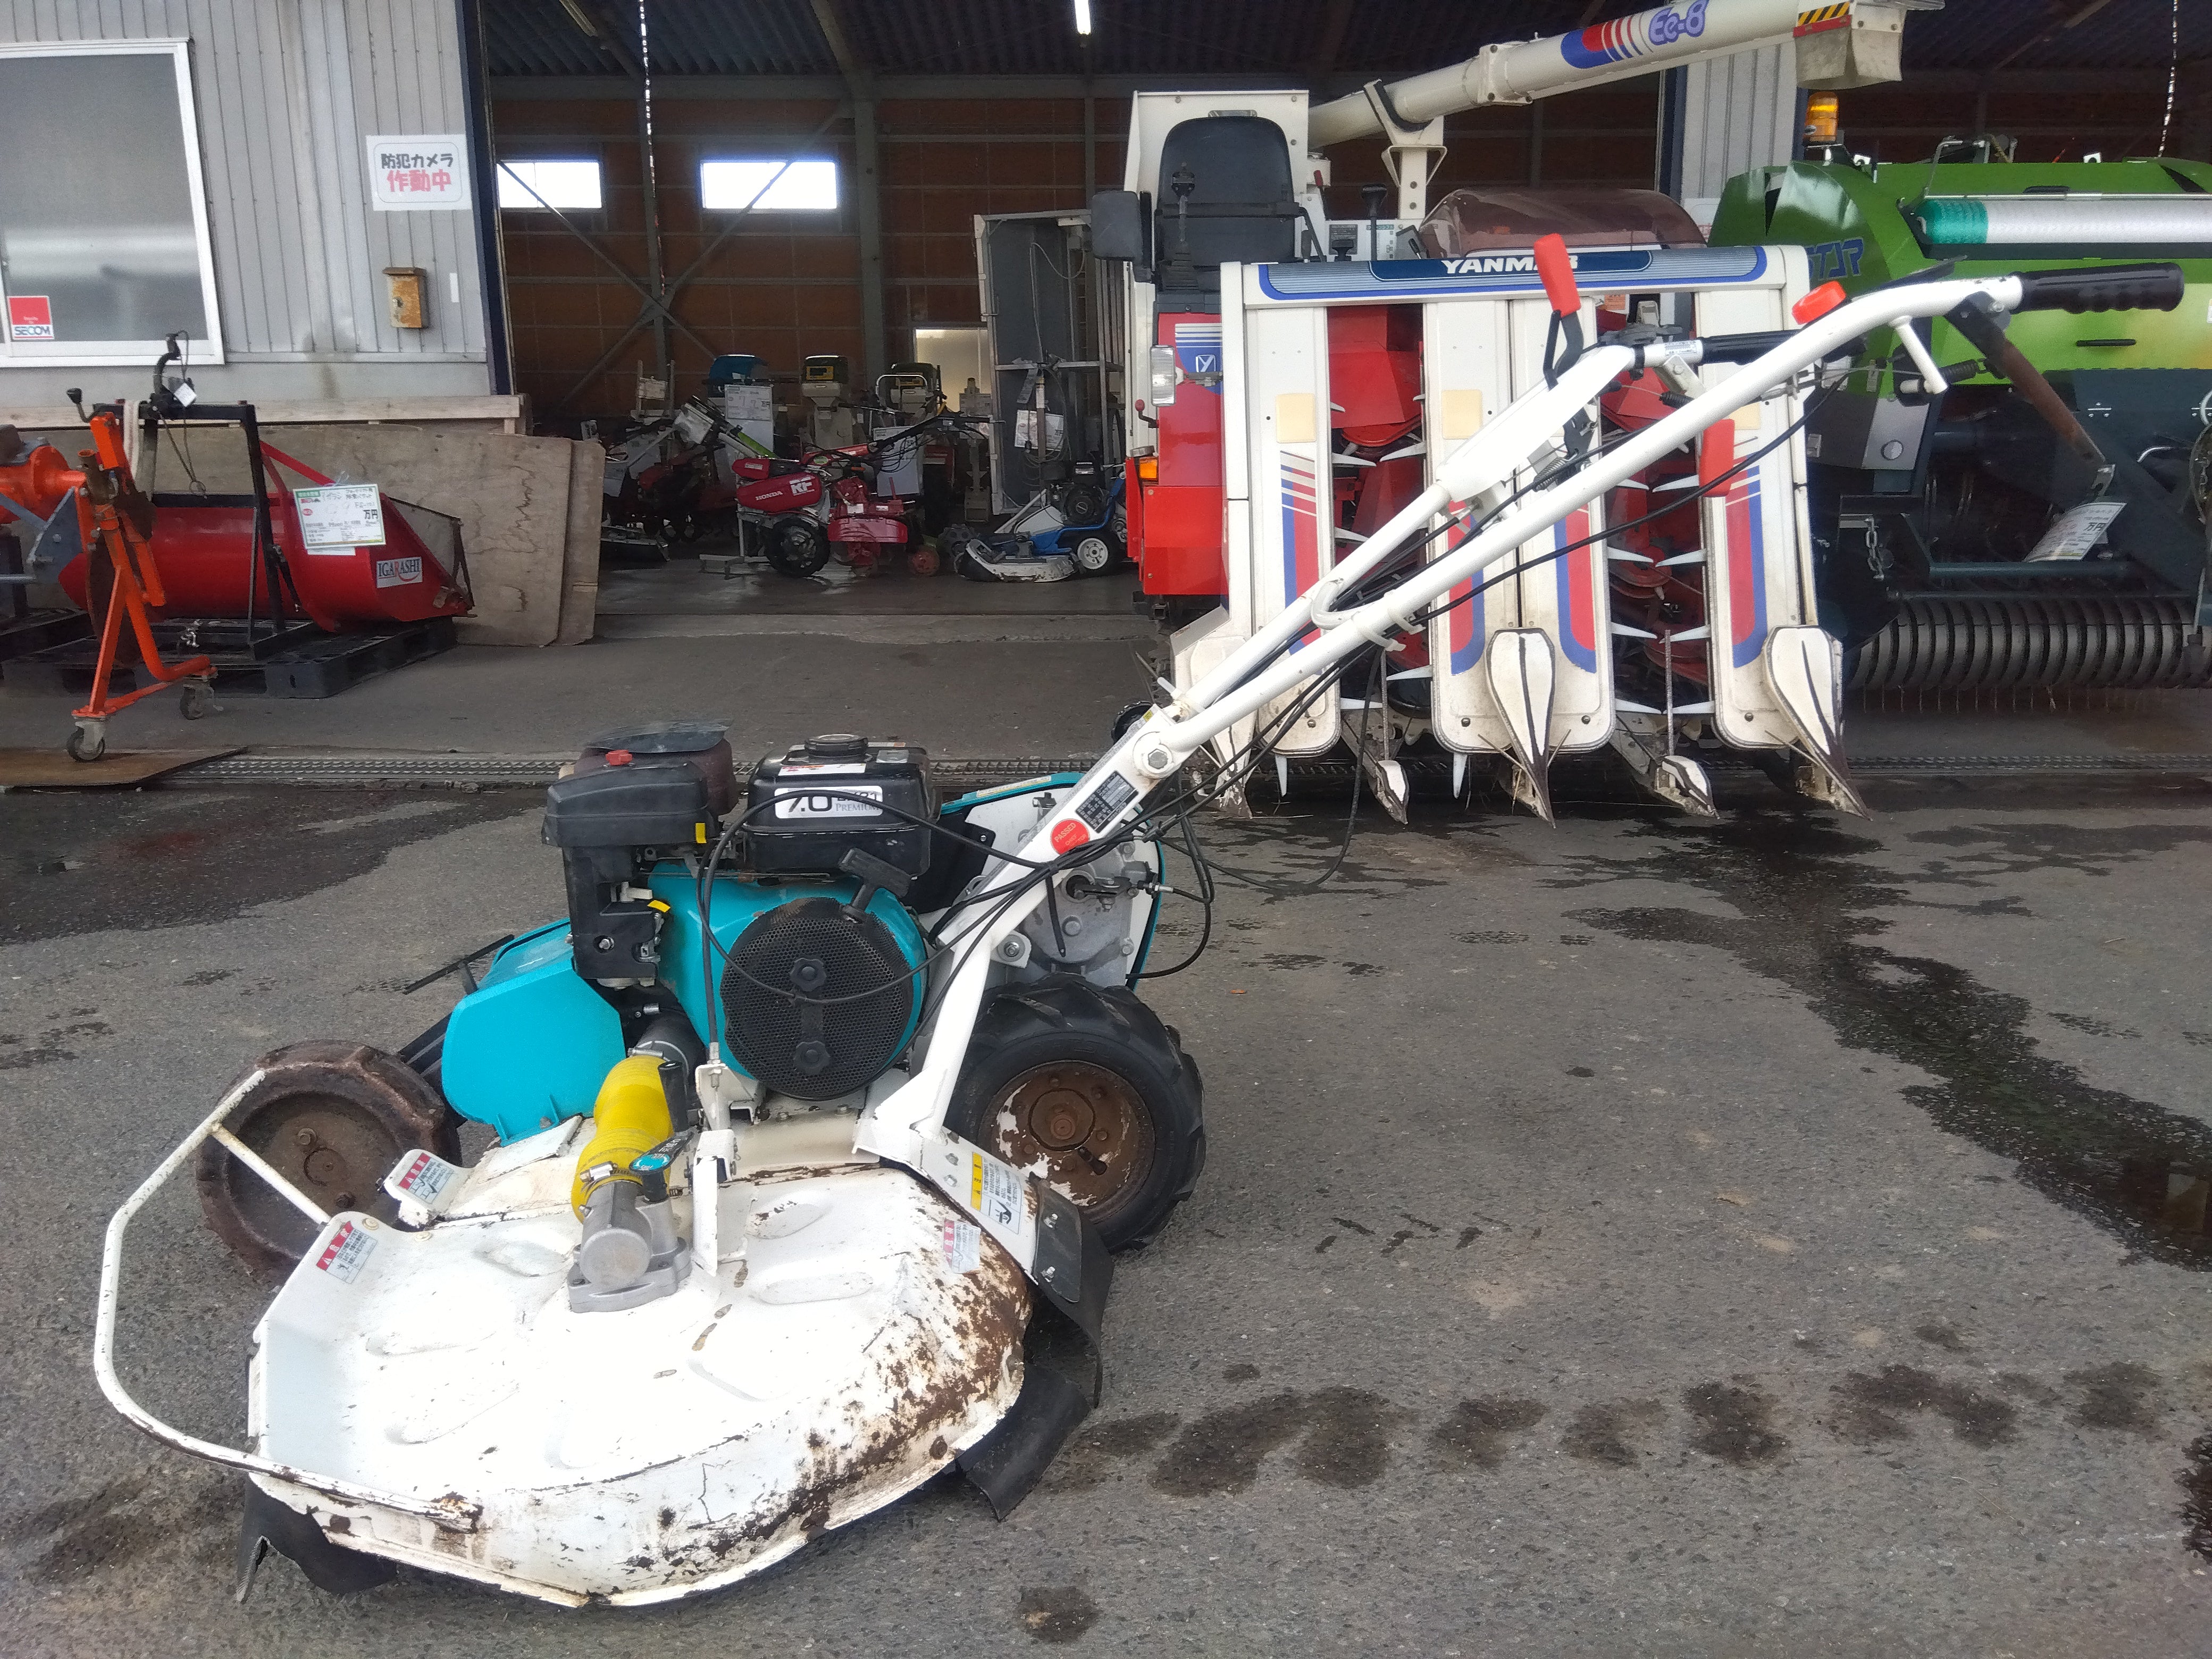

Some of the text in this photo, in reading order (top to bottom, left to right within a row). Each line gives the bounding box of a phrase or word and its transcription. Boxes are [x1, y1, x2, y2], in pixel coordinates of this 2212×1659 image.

[381, 153, 453, 169] 防犯カメラ
[387, 169, 451, 192] 作動中
[1441, 255, 1578, 274] YANM
[14, 325, 51, 336] SECOM
[755, 491, 783, 500] HONDA
[363, 509, 378, 520] 万円
[378, 558, 421, 577] IGARASHI
[1054, 823, 1076, 843] PASSED
